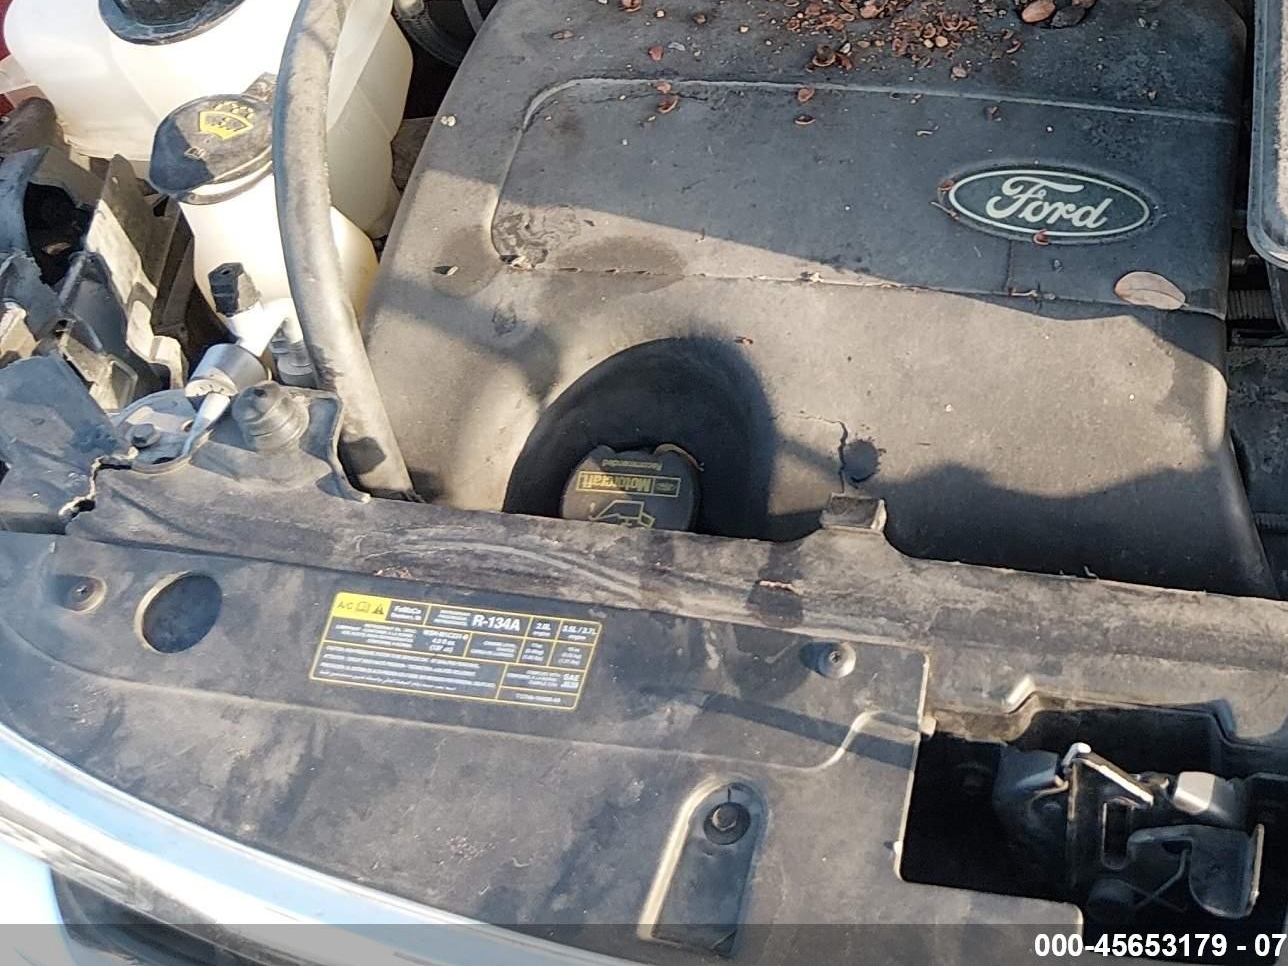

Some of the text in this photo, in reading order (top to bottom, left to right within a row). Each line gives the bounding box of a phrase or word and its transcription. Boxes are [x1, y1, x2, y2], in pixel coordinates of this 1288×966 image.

[985, 175, 1113, 229] Ford
[580, 473, 652, 493] Motorcraft
[471, 614, 521, 632] R-134A
